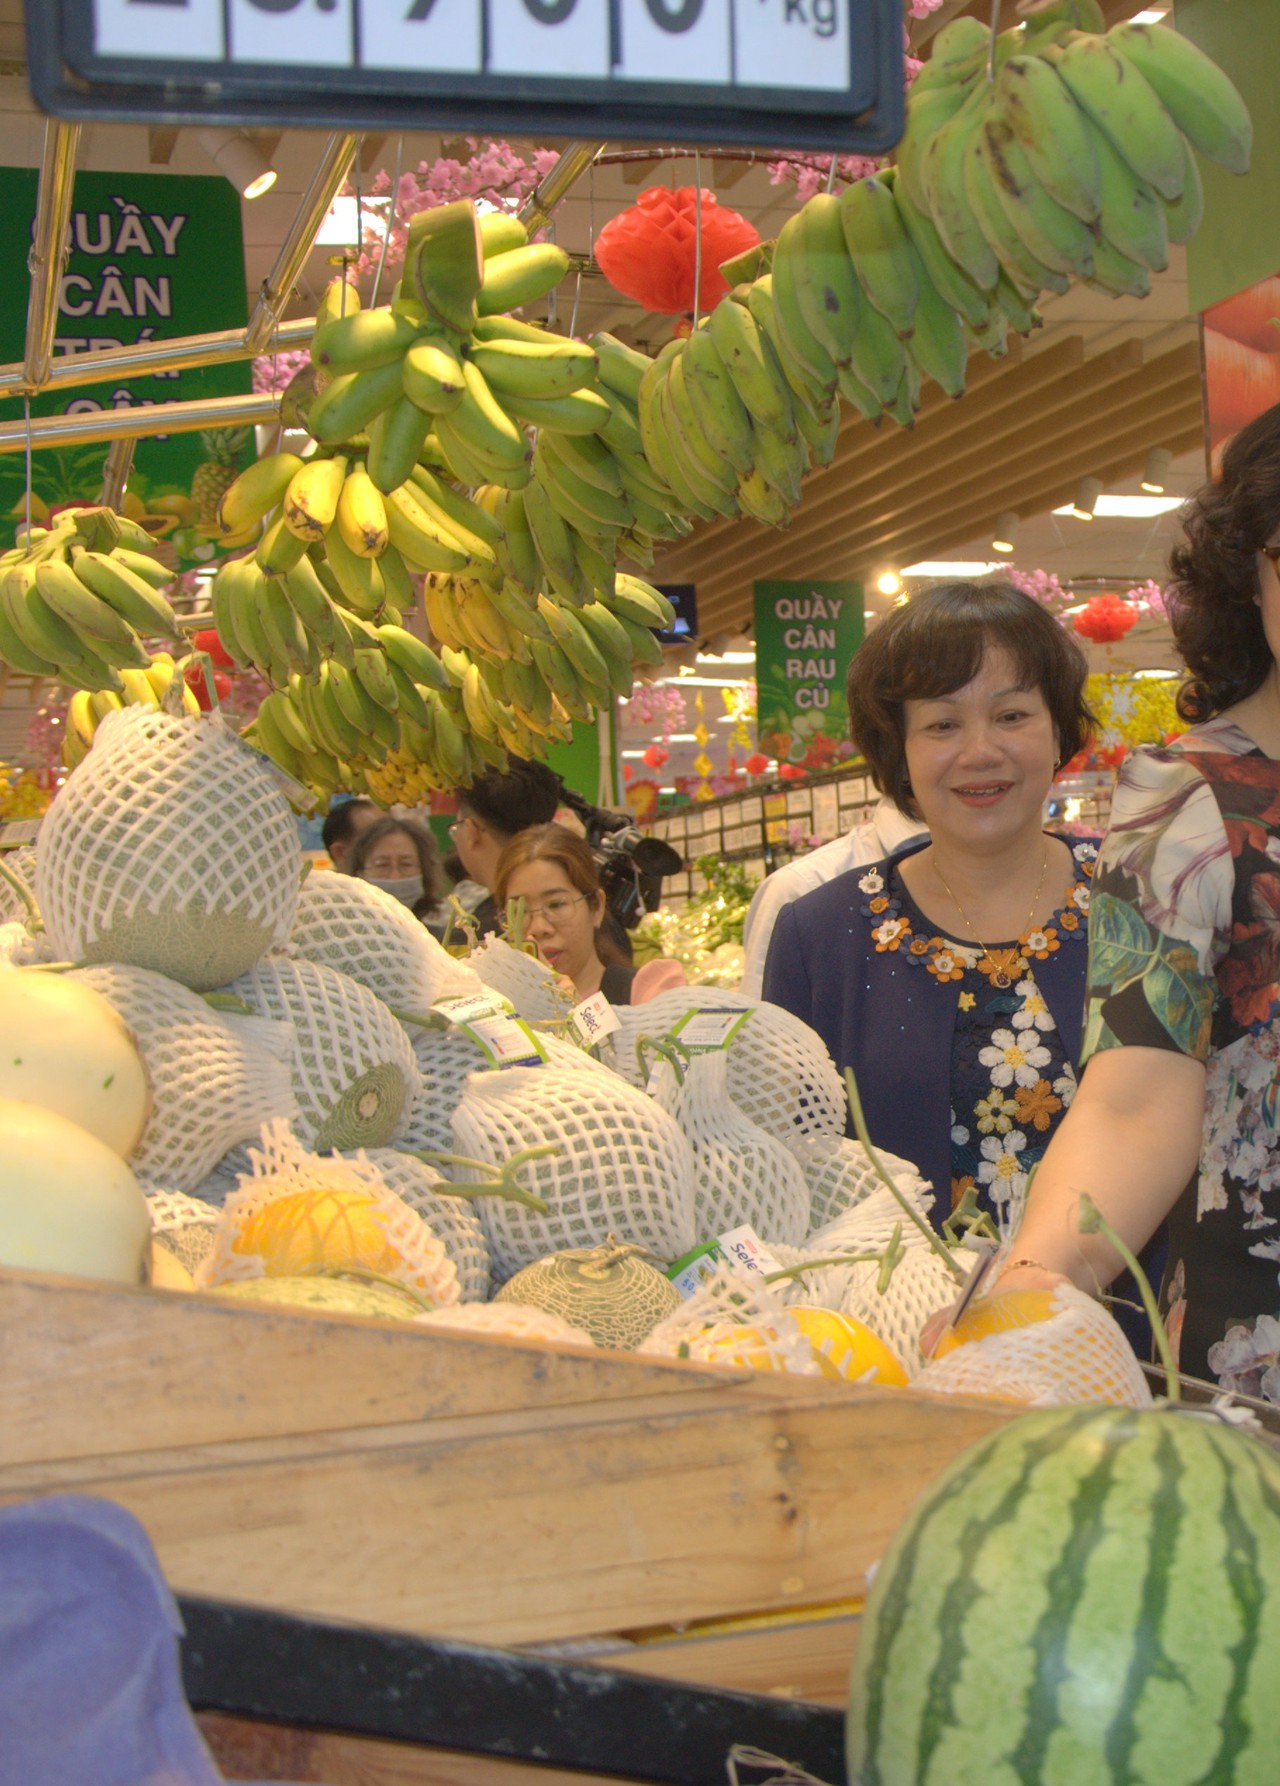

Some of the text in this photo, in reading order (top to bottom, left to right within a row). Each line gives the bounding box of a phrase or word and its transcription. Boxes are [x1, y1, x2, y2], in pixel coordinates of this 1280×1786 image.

[58, 265, 171, 317] CÂN
[775, 591, 843, 620] QUẦY
[784, 624, 836, 650] CÂN
[786, 659, 836, 679] RAU
[795, 683, 830, 708] CỦ
[580, 1006, 601, 1035] Select
[730, 1242, 765, 1276] Sele
